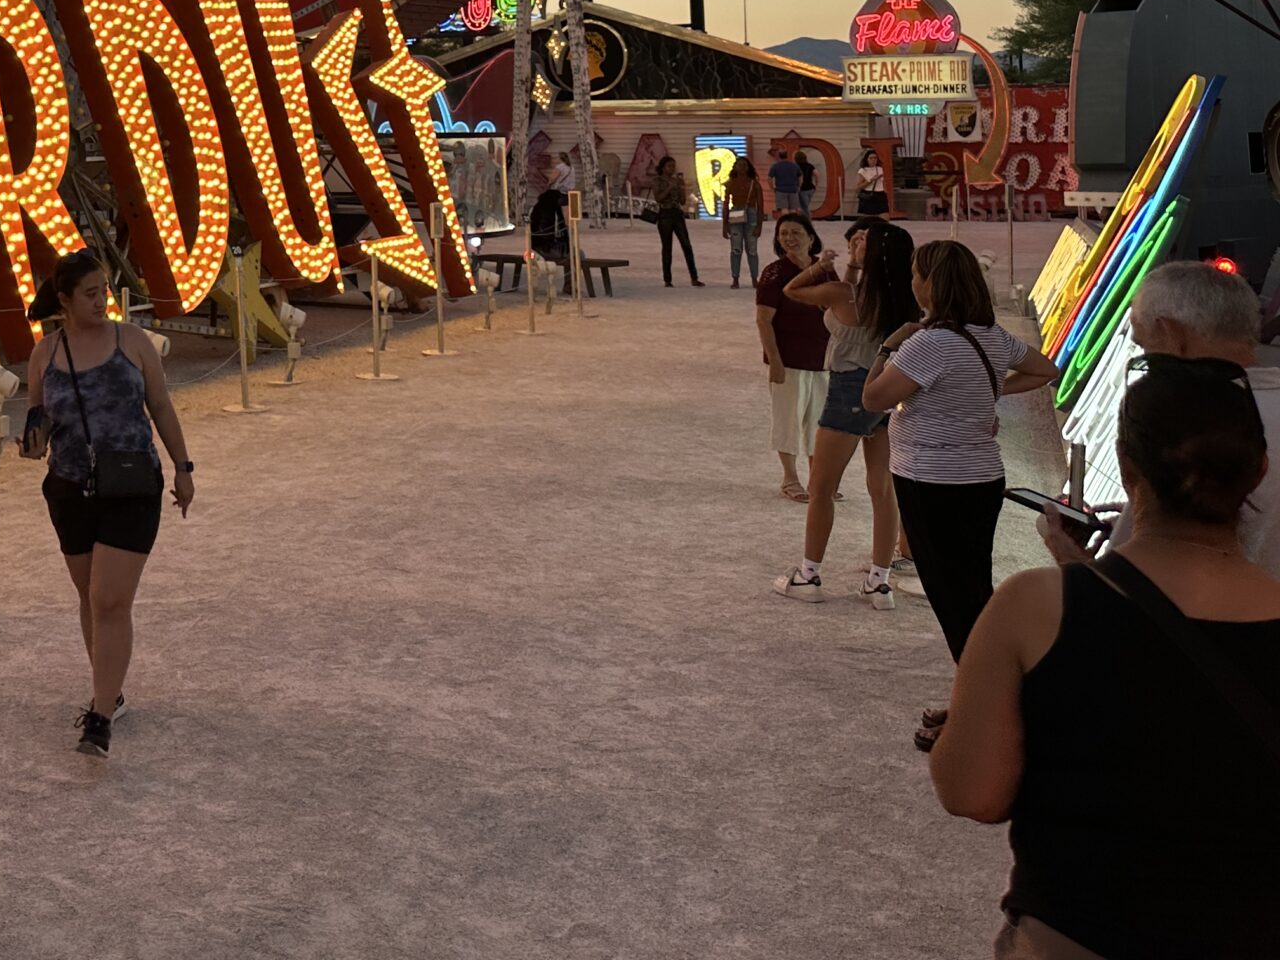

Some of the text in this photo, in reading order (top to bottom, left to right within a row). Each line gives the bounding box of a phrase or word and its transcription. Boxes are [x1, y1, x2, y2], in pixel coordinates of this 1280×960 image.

[855, 11, 956, 53] Flame
[847, 60, 968, 83] STEAK PRIME RIB
[849, 83, 968, 95] BREAKFAST LUNCH DINNER
[888, 103, 929, 116] 24 HRS
